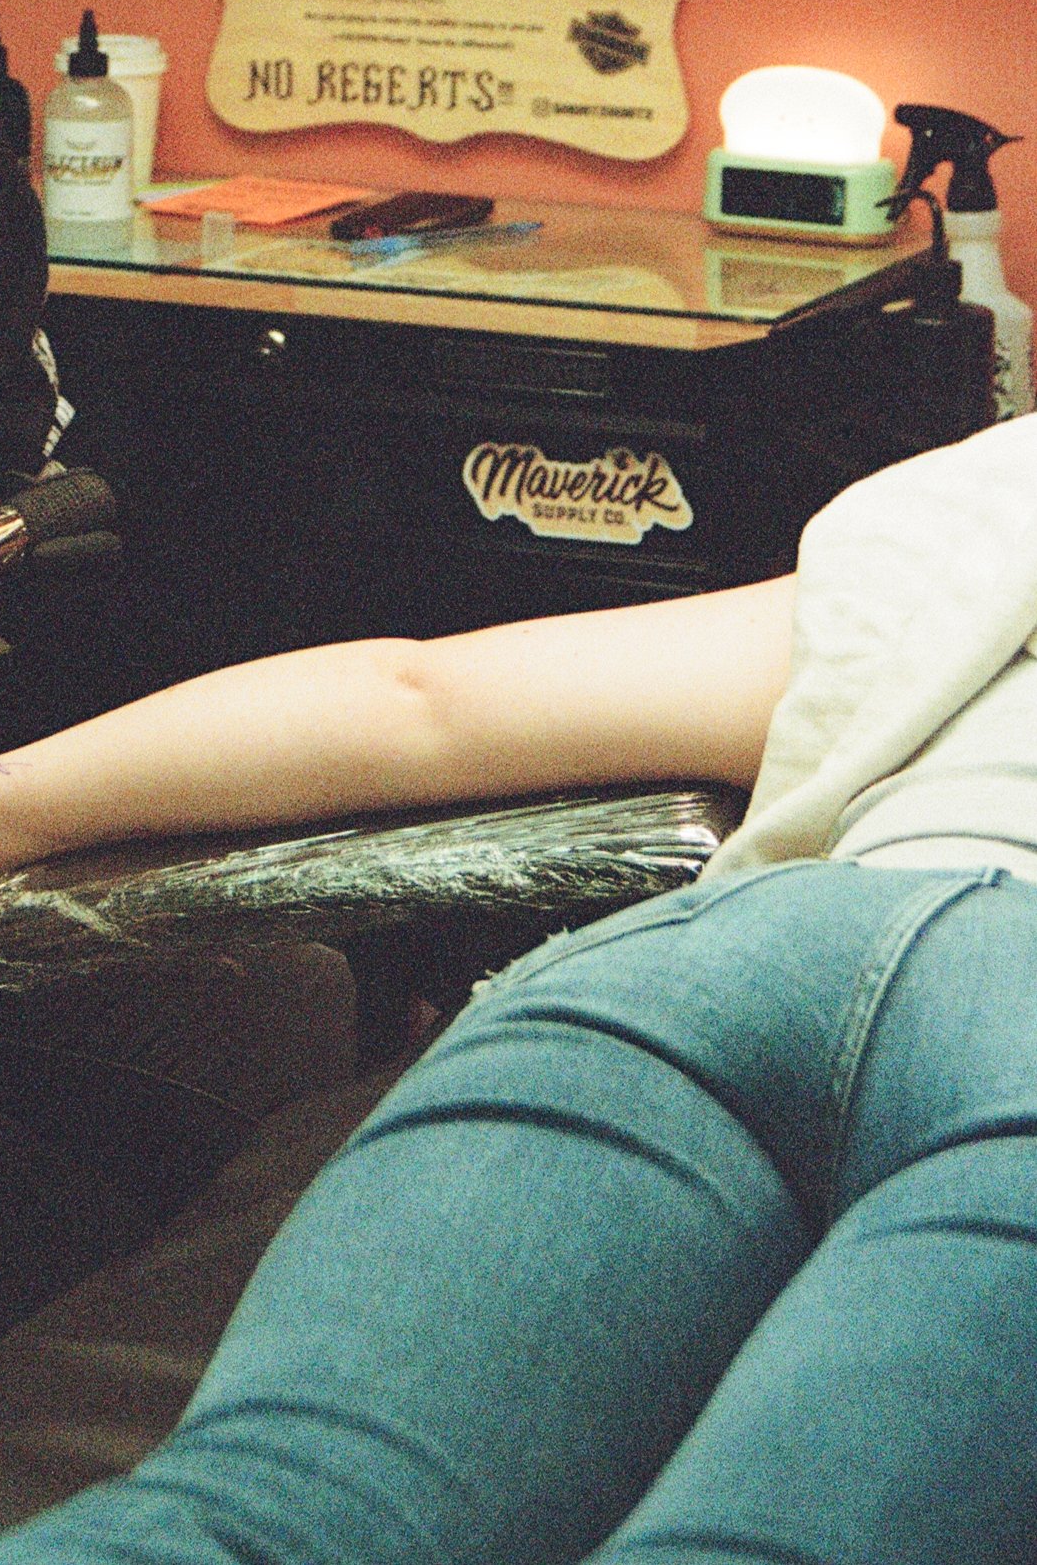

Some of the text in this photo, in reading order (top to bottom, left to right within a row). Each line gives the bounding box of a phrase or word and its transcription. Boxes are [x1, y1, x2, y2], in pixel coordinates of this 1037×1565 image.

[245, 57, 294, 102] NO
[470, 446, 682, 513] Maverick
[531, 502, 597, 524] SUPPLY
